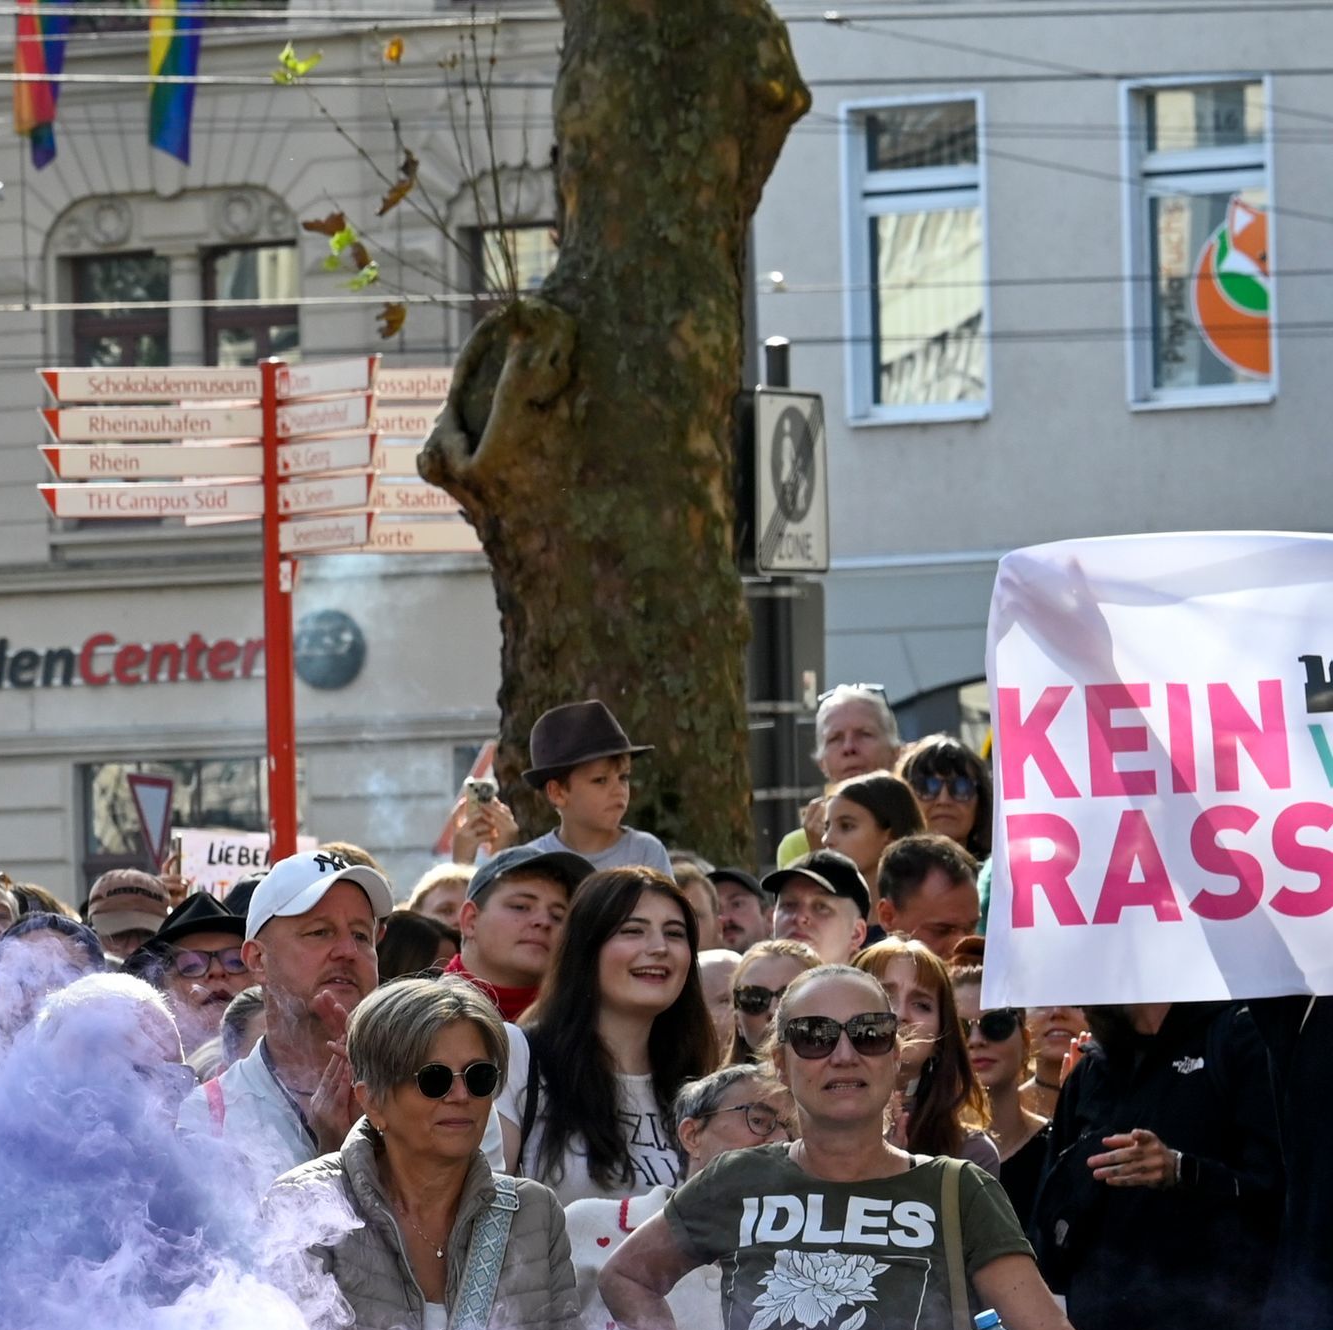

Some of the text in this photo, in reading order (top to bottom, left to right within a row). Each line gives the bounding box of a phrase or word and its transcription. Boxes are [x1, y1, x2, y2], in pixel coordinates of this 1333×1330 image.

[87, 375, 258, 395] Schokoladenmuseum
[88, 413, 212, 433] Rheinauhafen
[88, 450, 140, 471] Rhein
[87, 489, 228, 517] TH Campus Süd
[996, 679, 1291, 801] KEIN
[738, 1193, 937, 1249] IDLES
